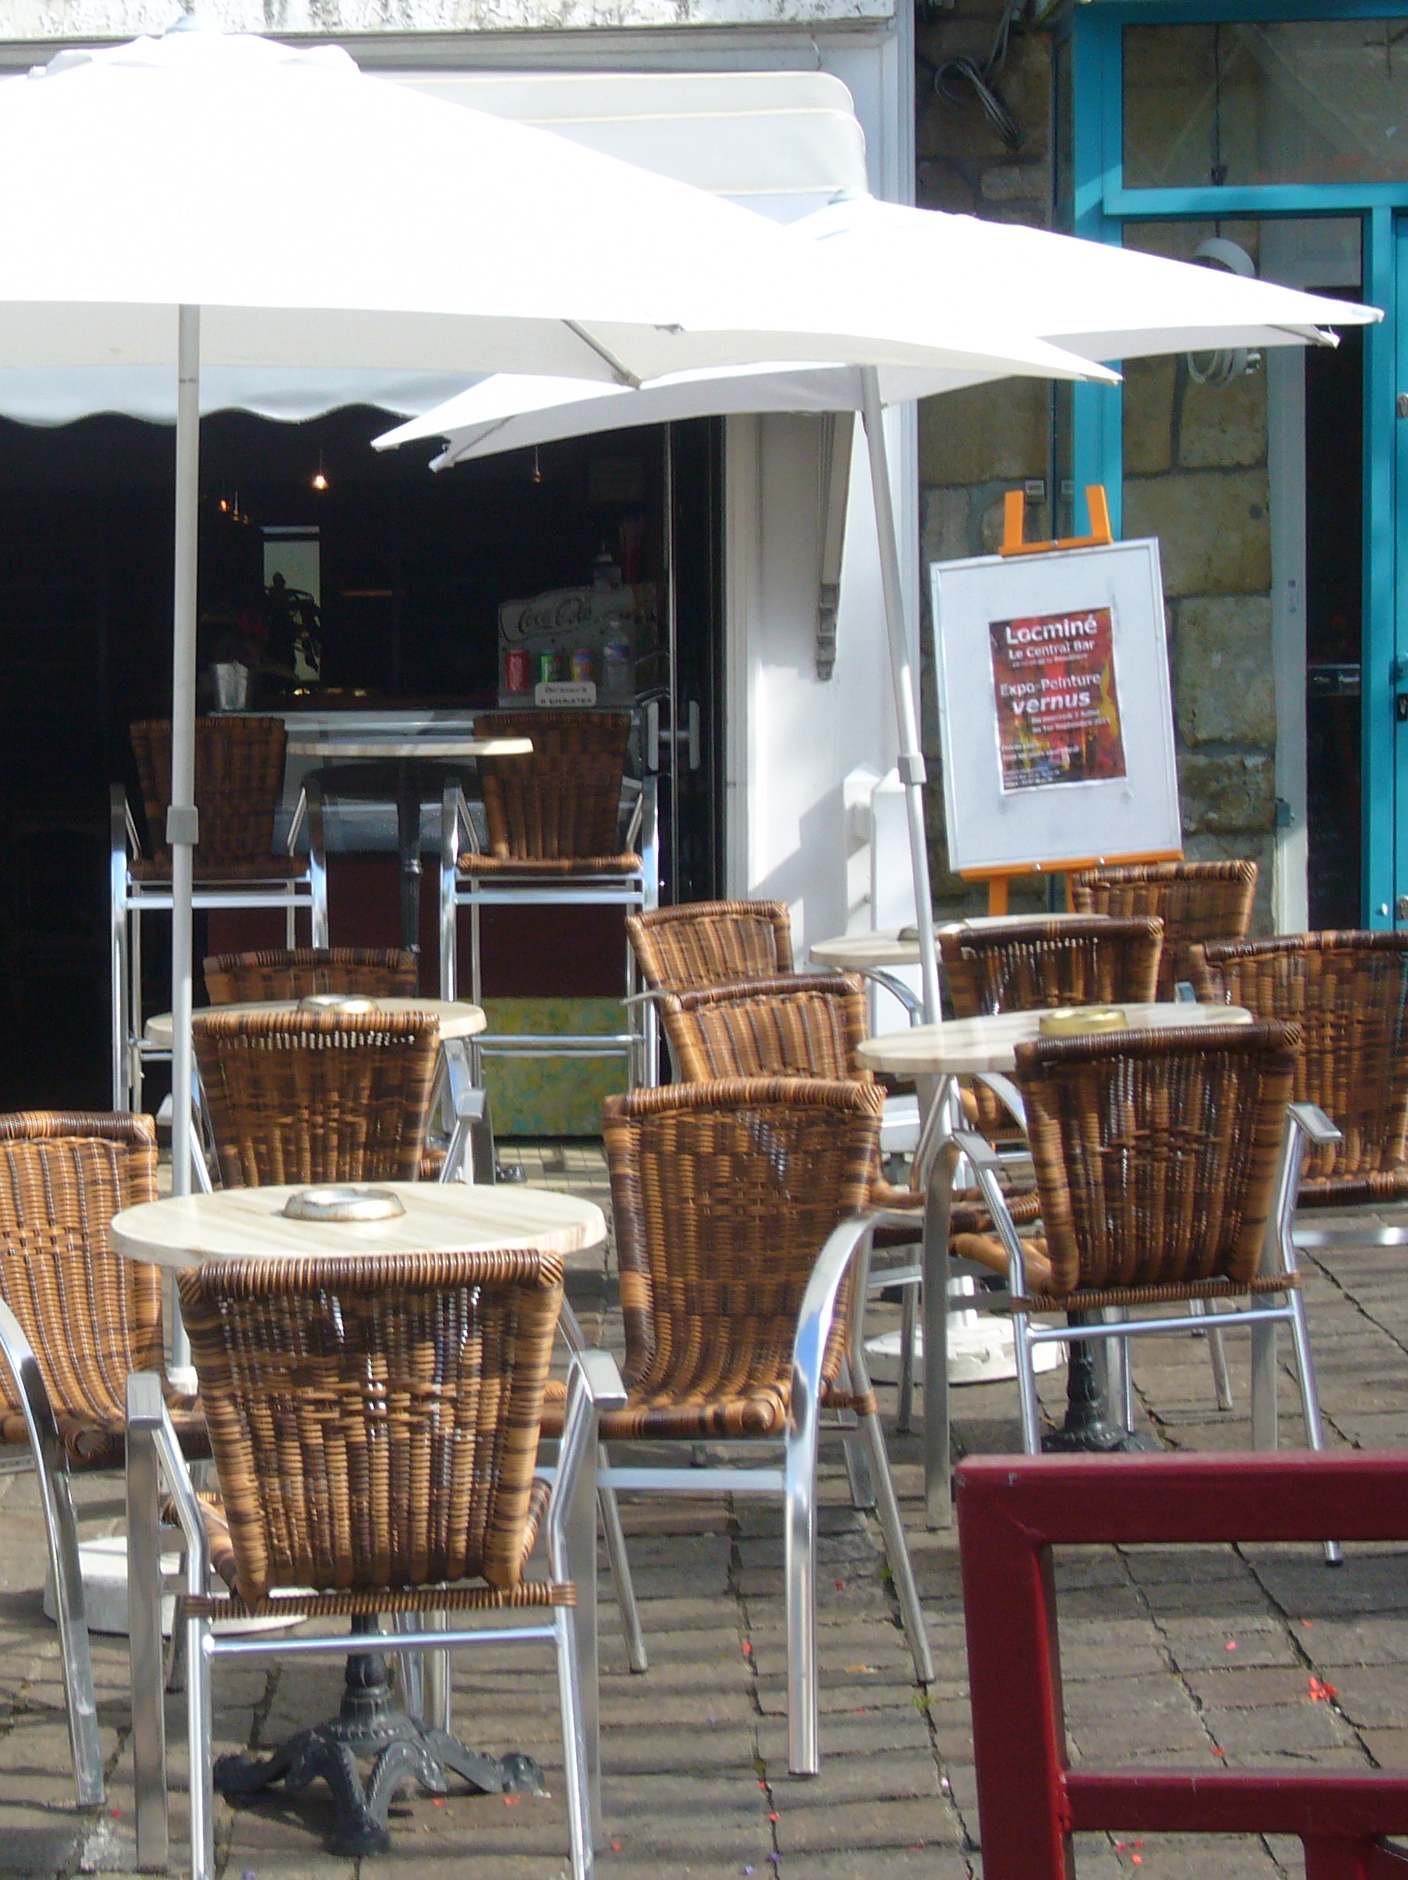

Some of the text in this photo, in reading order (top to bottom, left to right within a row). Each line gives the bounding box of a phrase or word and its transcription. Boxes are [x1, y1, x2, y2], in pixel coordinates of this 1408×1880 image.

[1005, 615, 1097, 645] Locminé
[1008, 648, 1024, 661] Le
[1026, 641, 1071, 659] Central
[1073, 640, 1095, 652] Bar
[1000, 674, 1100, 697] Expo-Peinture
[1012, 692, 1090, 714] vernus
